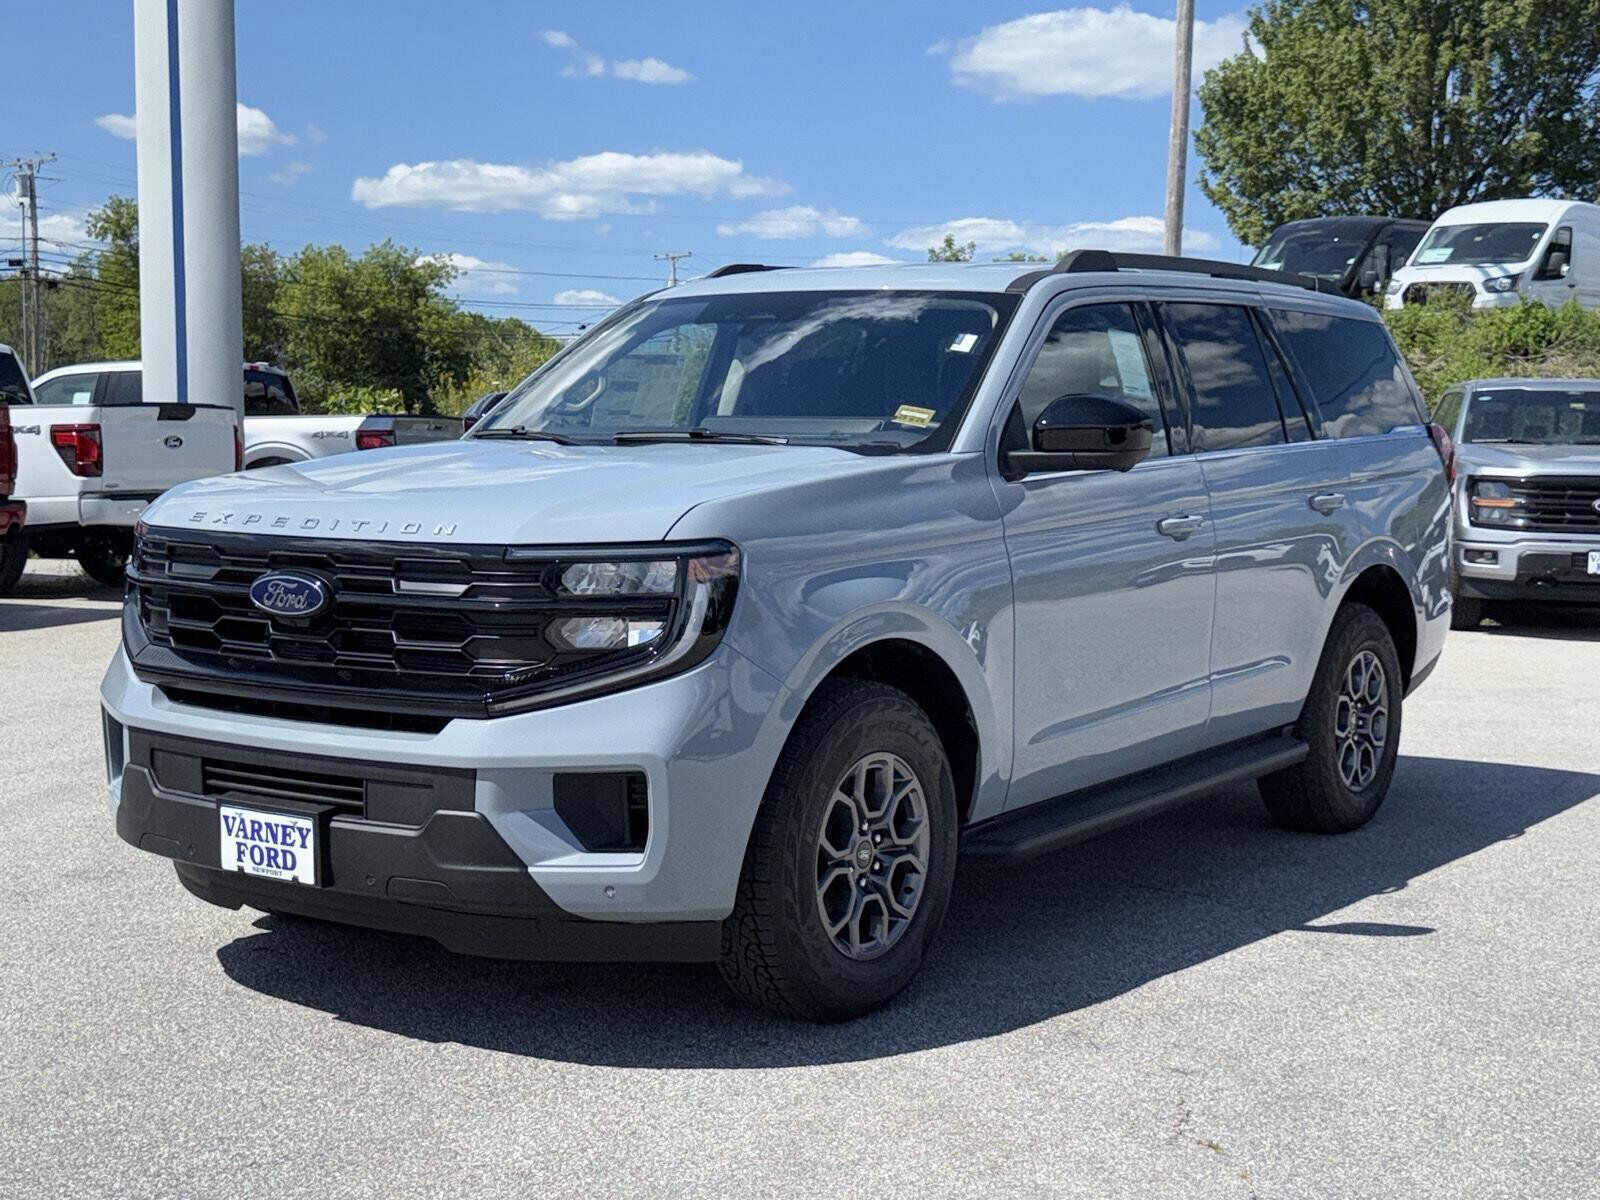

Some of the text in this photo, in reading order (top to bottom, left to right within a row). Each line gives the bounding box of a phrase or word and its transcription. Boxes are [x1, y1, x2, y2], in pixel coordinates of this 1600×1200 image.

[189, 511, 459, 536] EXPEDITION
[263, 580, 310, 609] Ford
[222, 814, 312, 849] VARNEY
[236, 841, 297, 872] FORD
